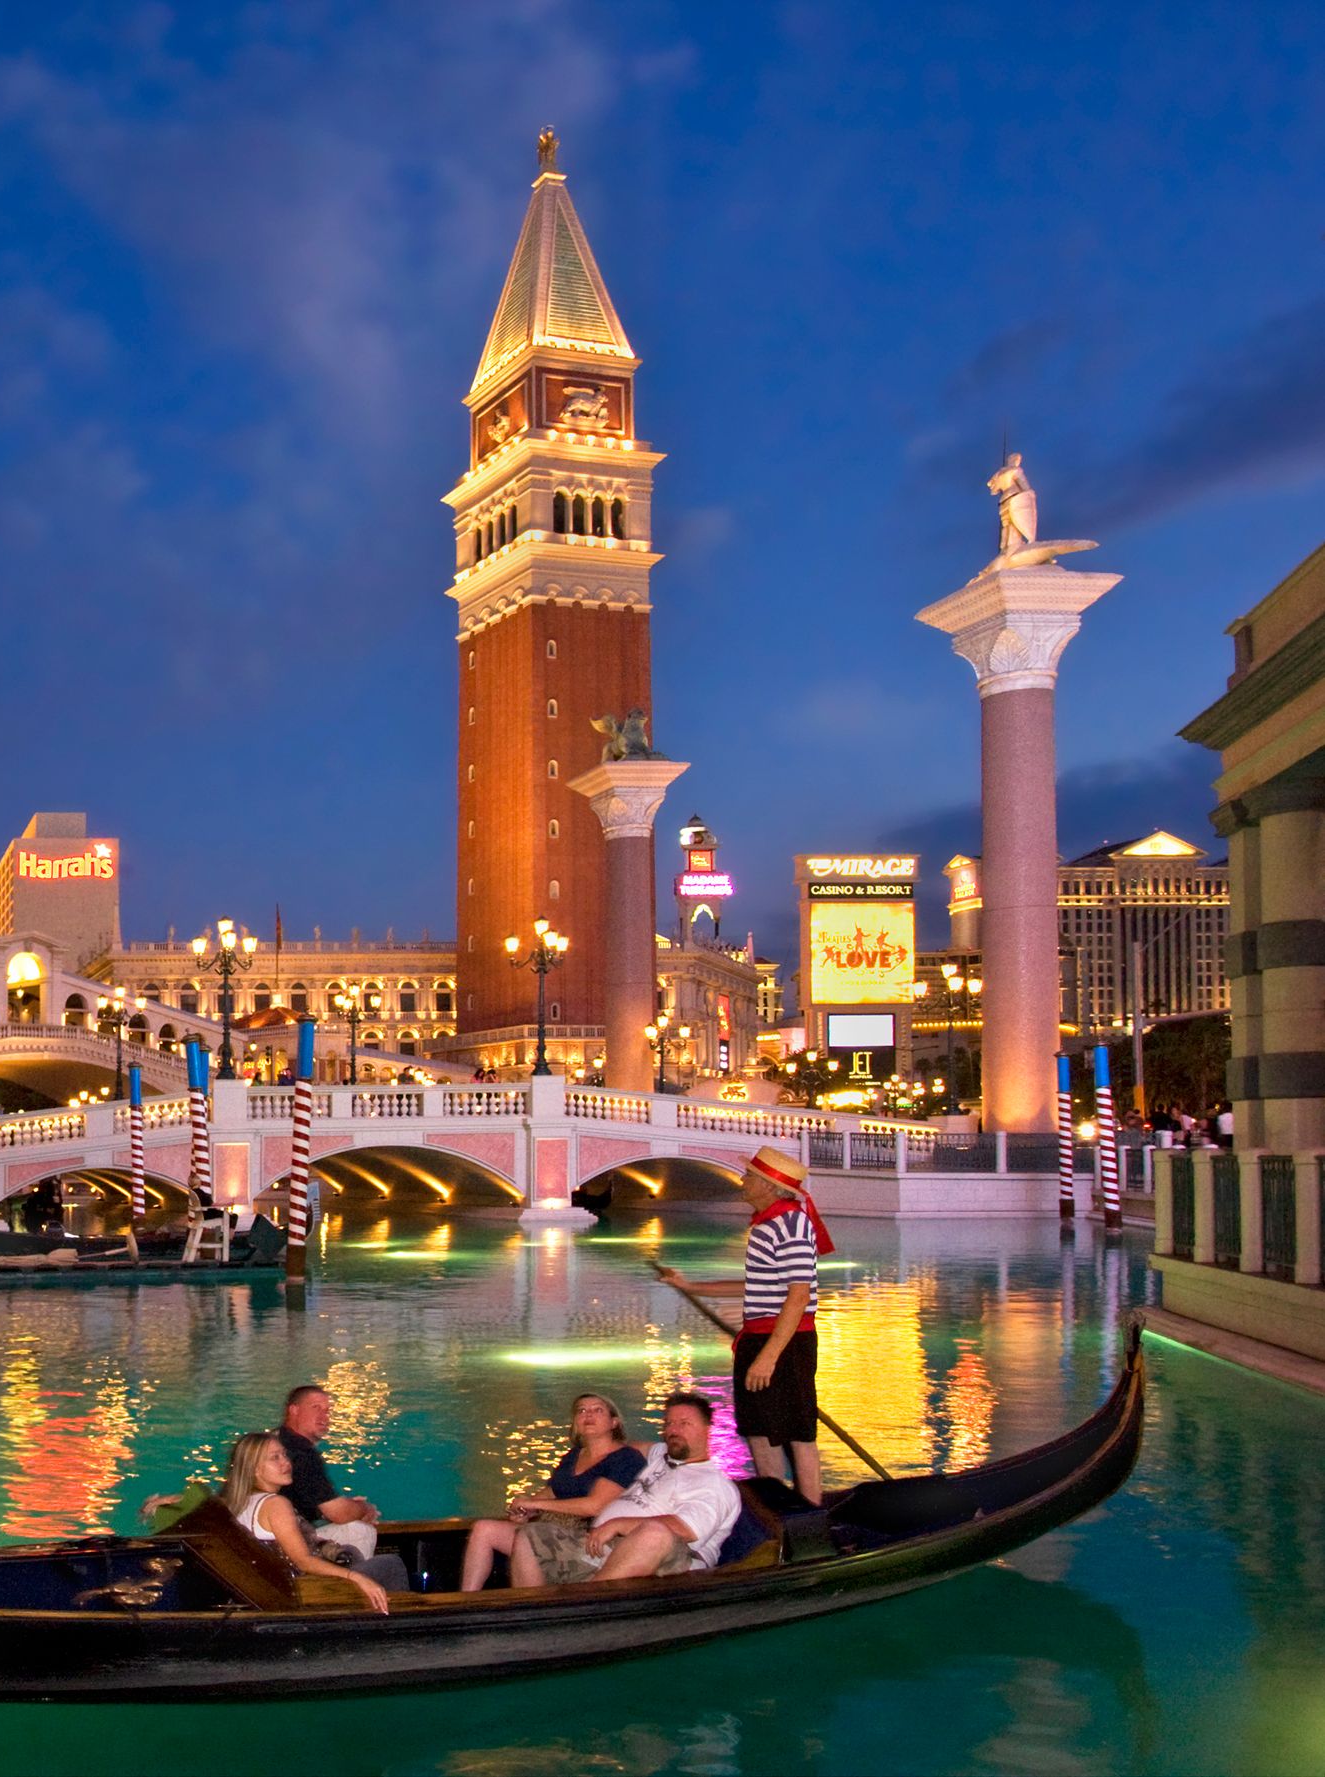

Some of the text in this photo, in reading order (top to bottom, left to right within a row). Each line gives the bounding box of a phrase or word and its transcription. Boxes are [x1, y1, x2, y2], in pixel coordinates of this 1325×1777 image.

[831, 858, 915, 878] MIRAGE
[811, 885, 912, 895] CASINO & RESORT
[836, 951, 891, 968] LOVE
[849, 1052, 872, 1074] JET
